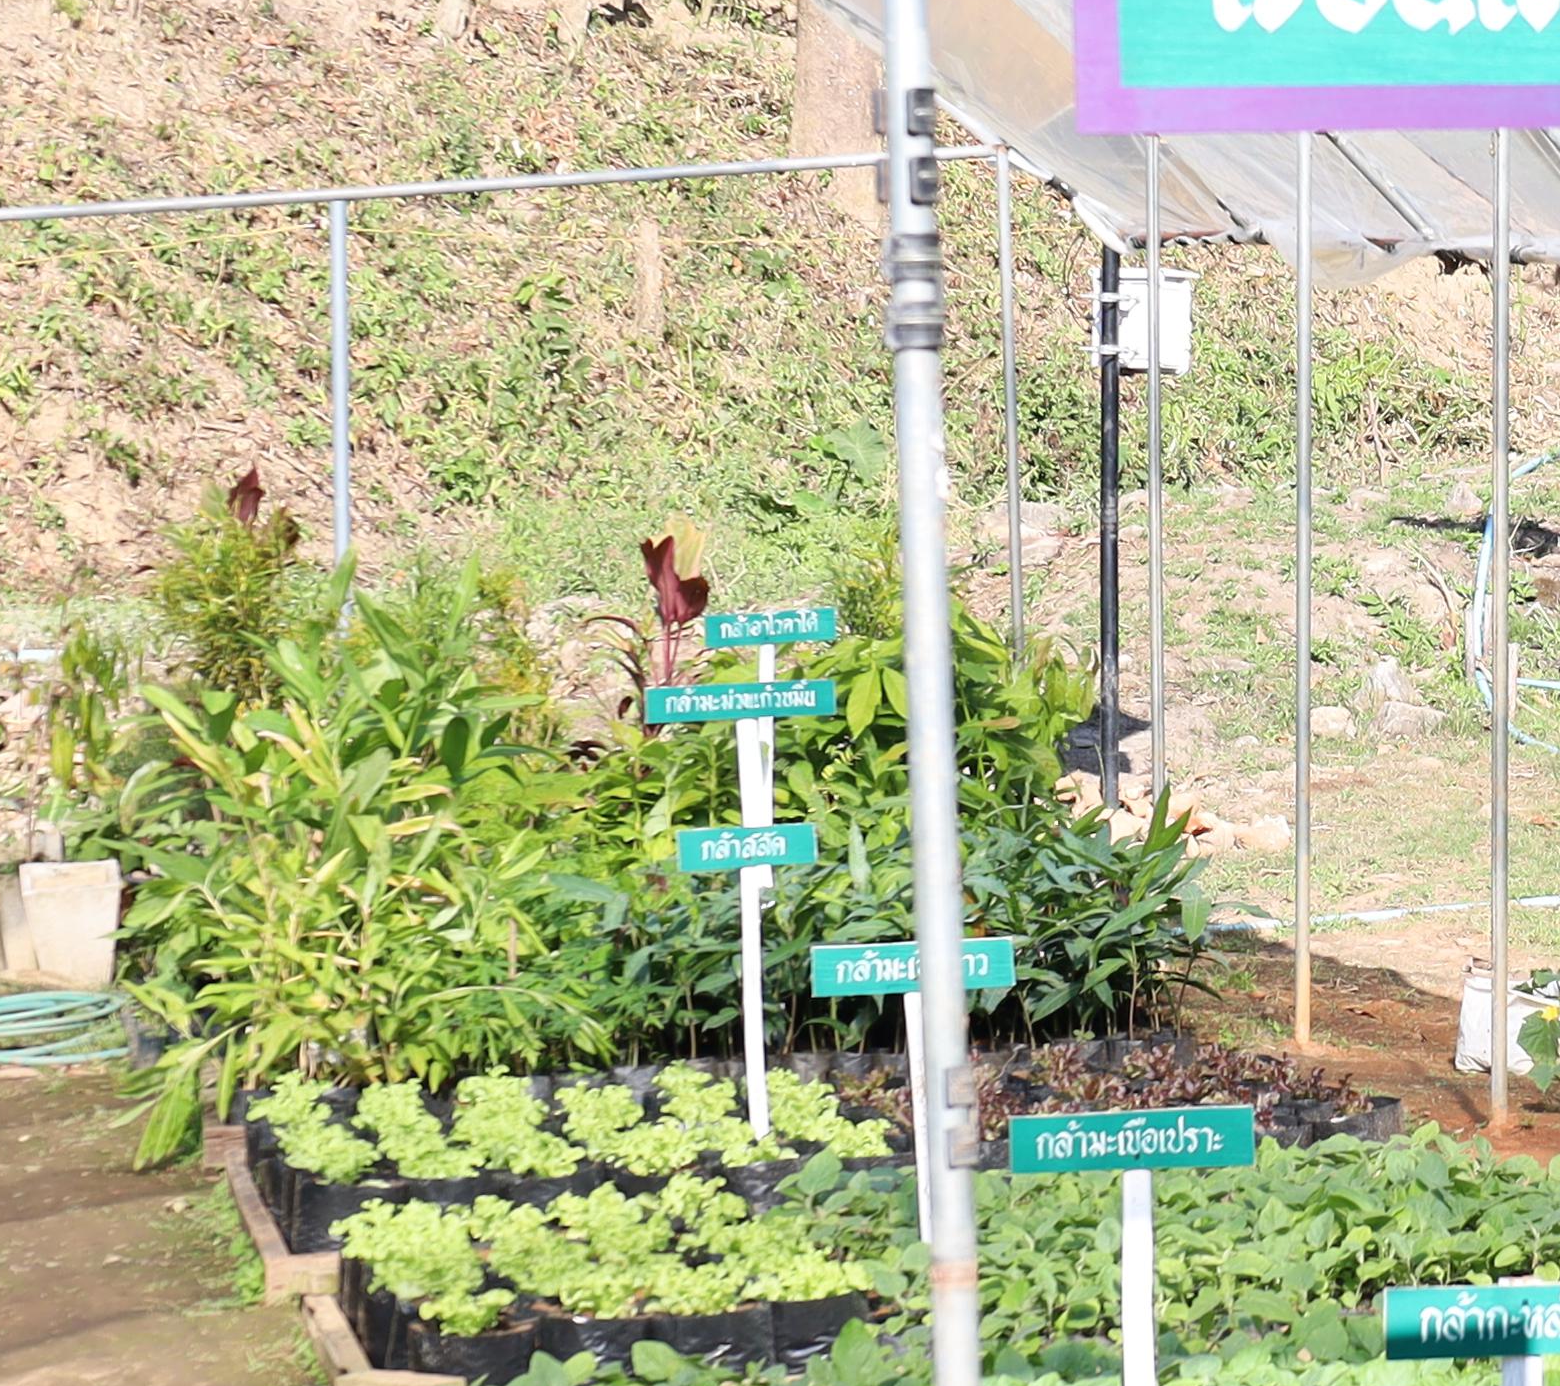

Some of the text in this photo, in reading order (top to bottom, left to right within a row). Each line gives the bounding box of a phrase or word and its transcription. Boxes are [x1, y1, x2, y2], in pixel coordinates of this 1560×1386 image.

[1035, 1115, 1226, 1161] กล้ามะเขือเปราะ
